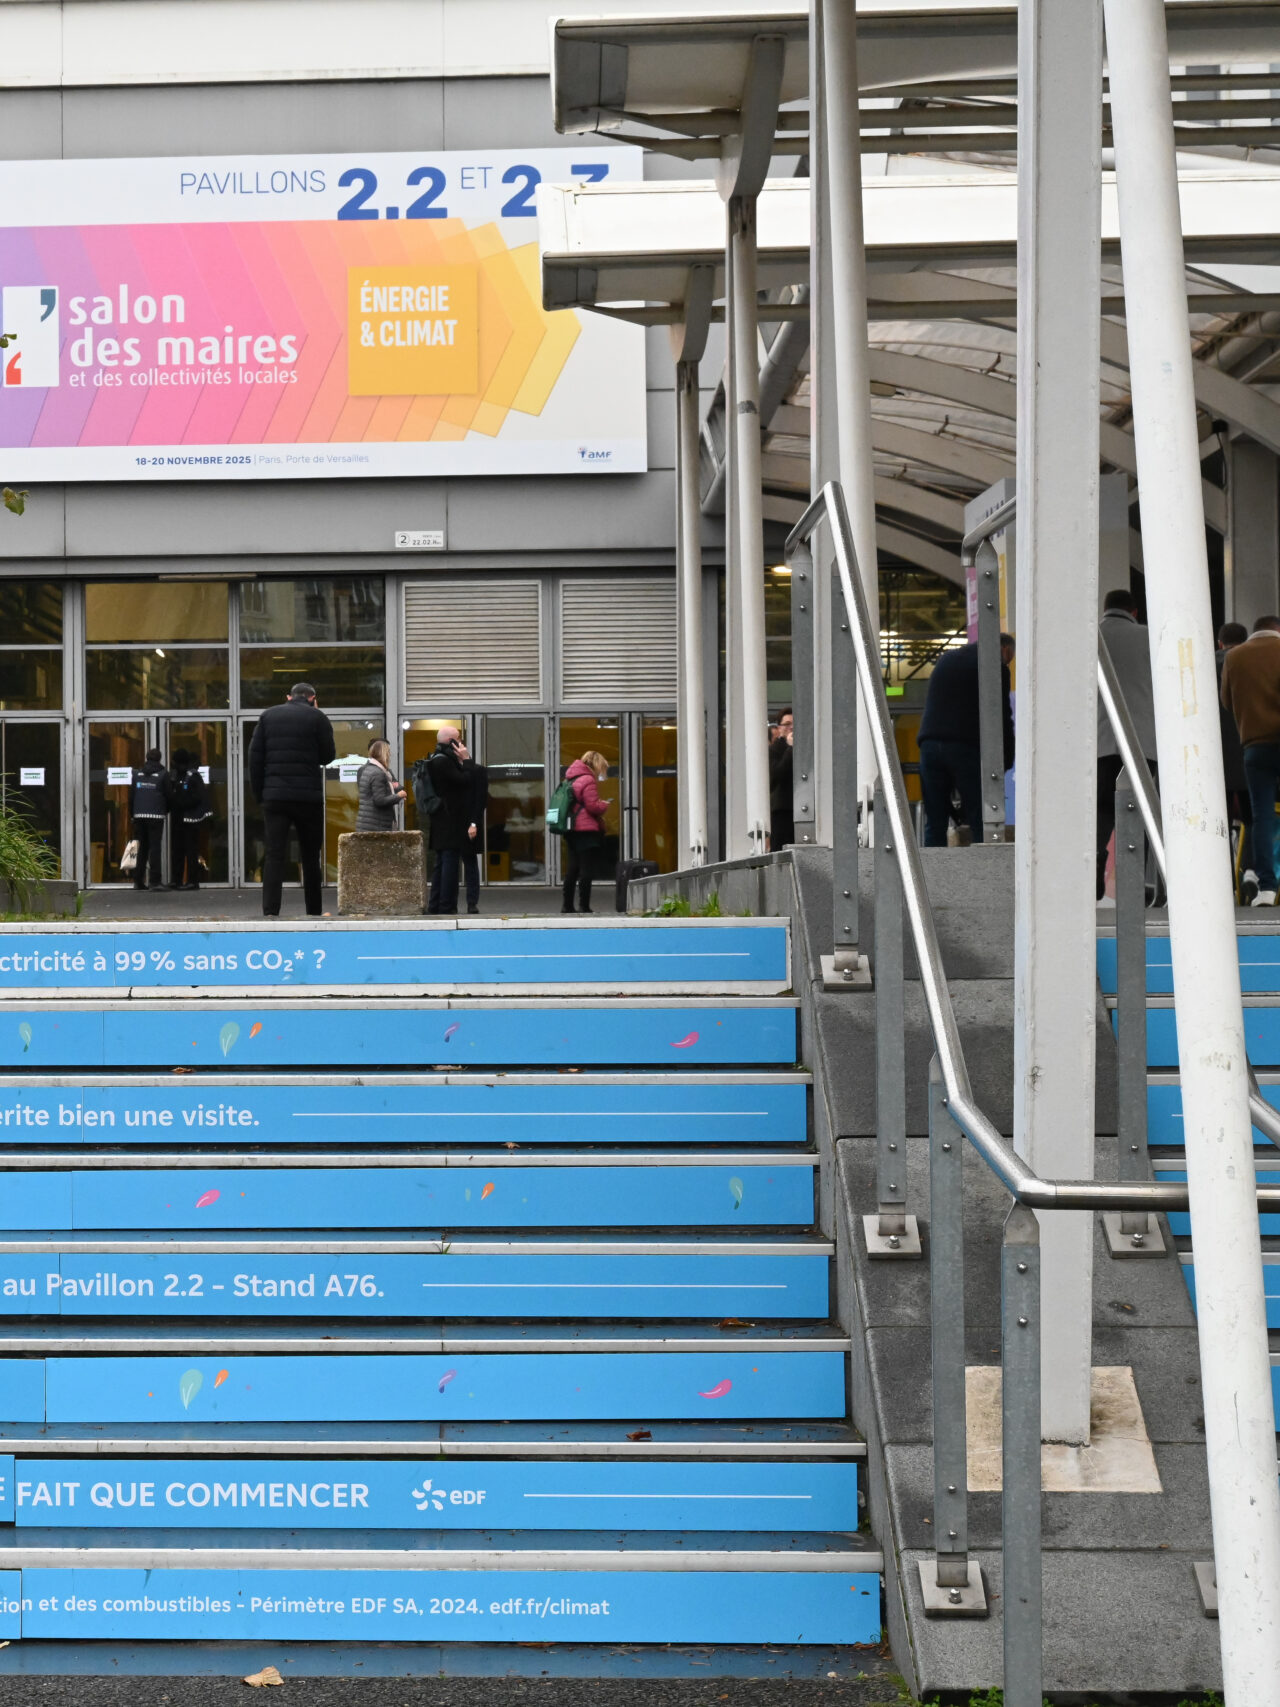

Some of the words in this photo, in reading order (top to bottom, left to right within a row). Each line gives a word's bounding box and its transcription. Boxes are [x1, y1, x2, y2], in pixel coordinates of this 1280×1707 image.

[180, 169, 326, 195] PAVILLONS
[337, 166, 449, 220] 2.2
[460, 166, 493, 190] ET
[69, 284, 186, 326] salon
[359, 280, 450, 314] ÉNERGIE
[70, 327, 141, 367] des
[157, 325, 298, 366] maires
[359, 322, 376, 348] &
[379, 319, 458, 348] CLIMAT
[69, 369, 86, 387] et
[93, 368, 123, 387] des
[130, 367, 232, 387] collectivités
[239, 366, 298, 385] locales
[135, 457, 165, 467] 18-20
[167, 456, 224, 466] NOVEMBRE
[225, 455, 252, 465] 2025
[286, 455, 311, 464] Porte
[313, 454, 325, 464] de
[326, 454, 370, 464] Versailles
[93, 950, 107, 971] à
[183, 954, 238, 970] sans
[313, 949, 326, 969] ?
[58, 1103, 115, 1127] bien
[124, 1109, 174, 1127] une
[182, 1103, 260, 1126] visite.
[3, 1279, 36, 1296] au
[46, 1273, 154, 1297] Pavillon
[164, 1274, 204, 1297] 2.2
[233, 1273, 315, 1297] Stand
[324, 1274, 385, 1297] A76.
[17, 1481, 81, 1507] FAIT
[90, 1482, 155, 1509] QUE
[165, 1482, 369, 1508] COMMENCER
[38, 1597, 59, 1612] et
[64, 1595, 97, 1612] des
[102, 1595, 231, 1613] combustibles
[250, 1596, 345, 1614] Périmètre
[351, 1597, 387, 1614] EDF
[393, 1597, 424, 1616] SA,
[429, 1598, 484, 1614] 2024.
[489, 1597, 610, 1618] edf.fr/climat
